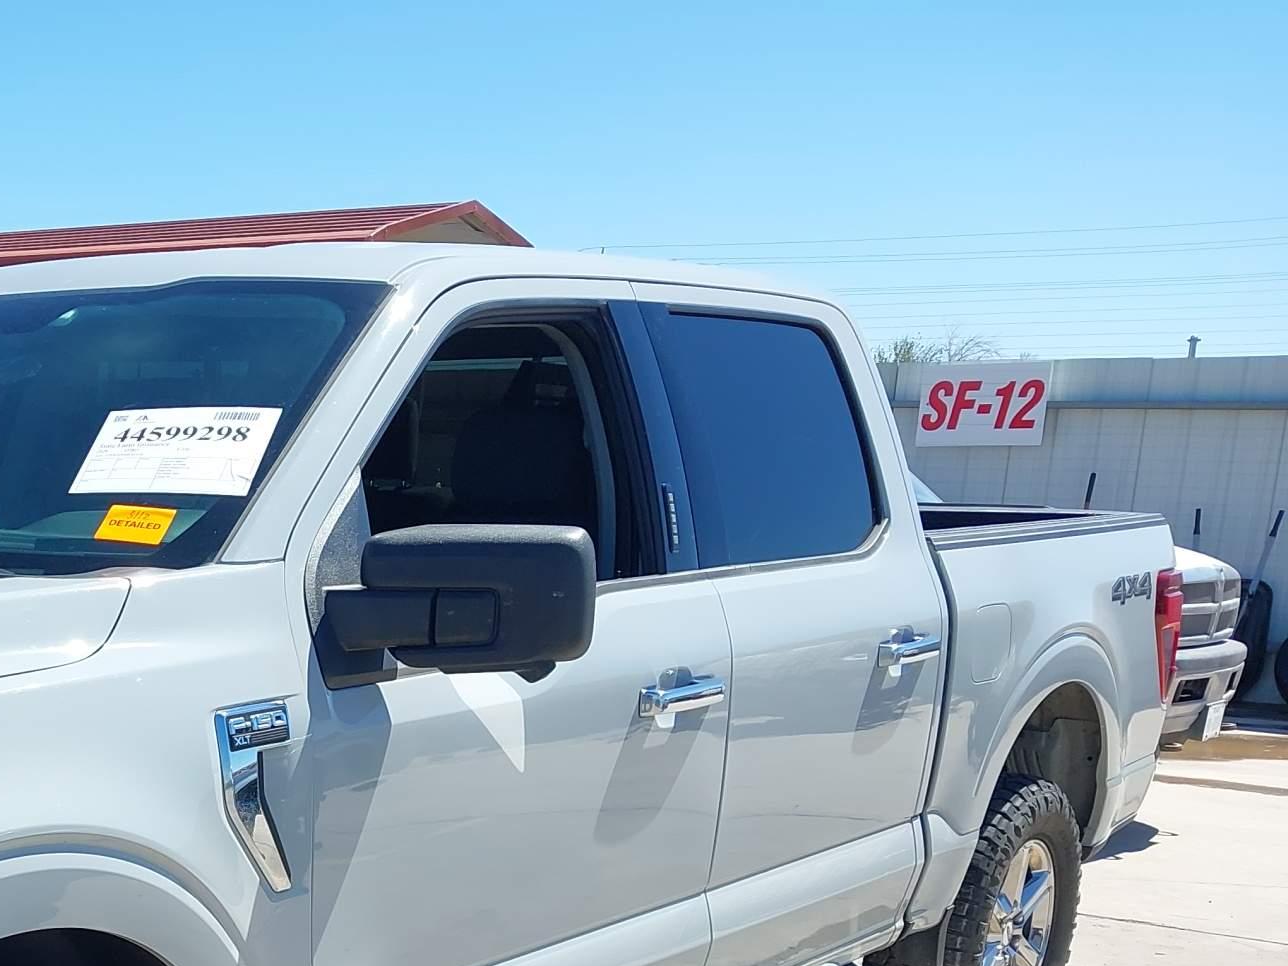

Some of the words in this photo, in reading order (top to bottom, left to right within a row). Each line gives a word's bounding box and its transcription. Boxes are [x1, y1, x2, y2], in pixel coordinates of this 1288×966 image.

[920, 379, 1046, 432] SF-12
[113, 425, 251, 443] 44599298
[108, 518, 162, 531] DETAILED
[228, 709, 288, 736] F-150
[233, 735, 252, 747] XLT
